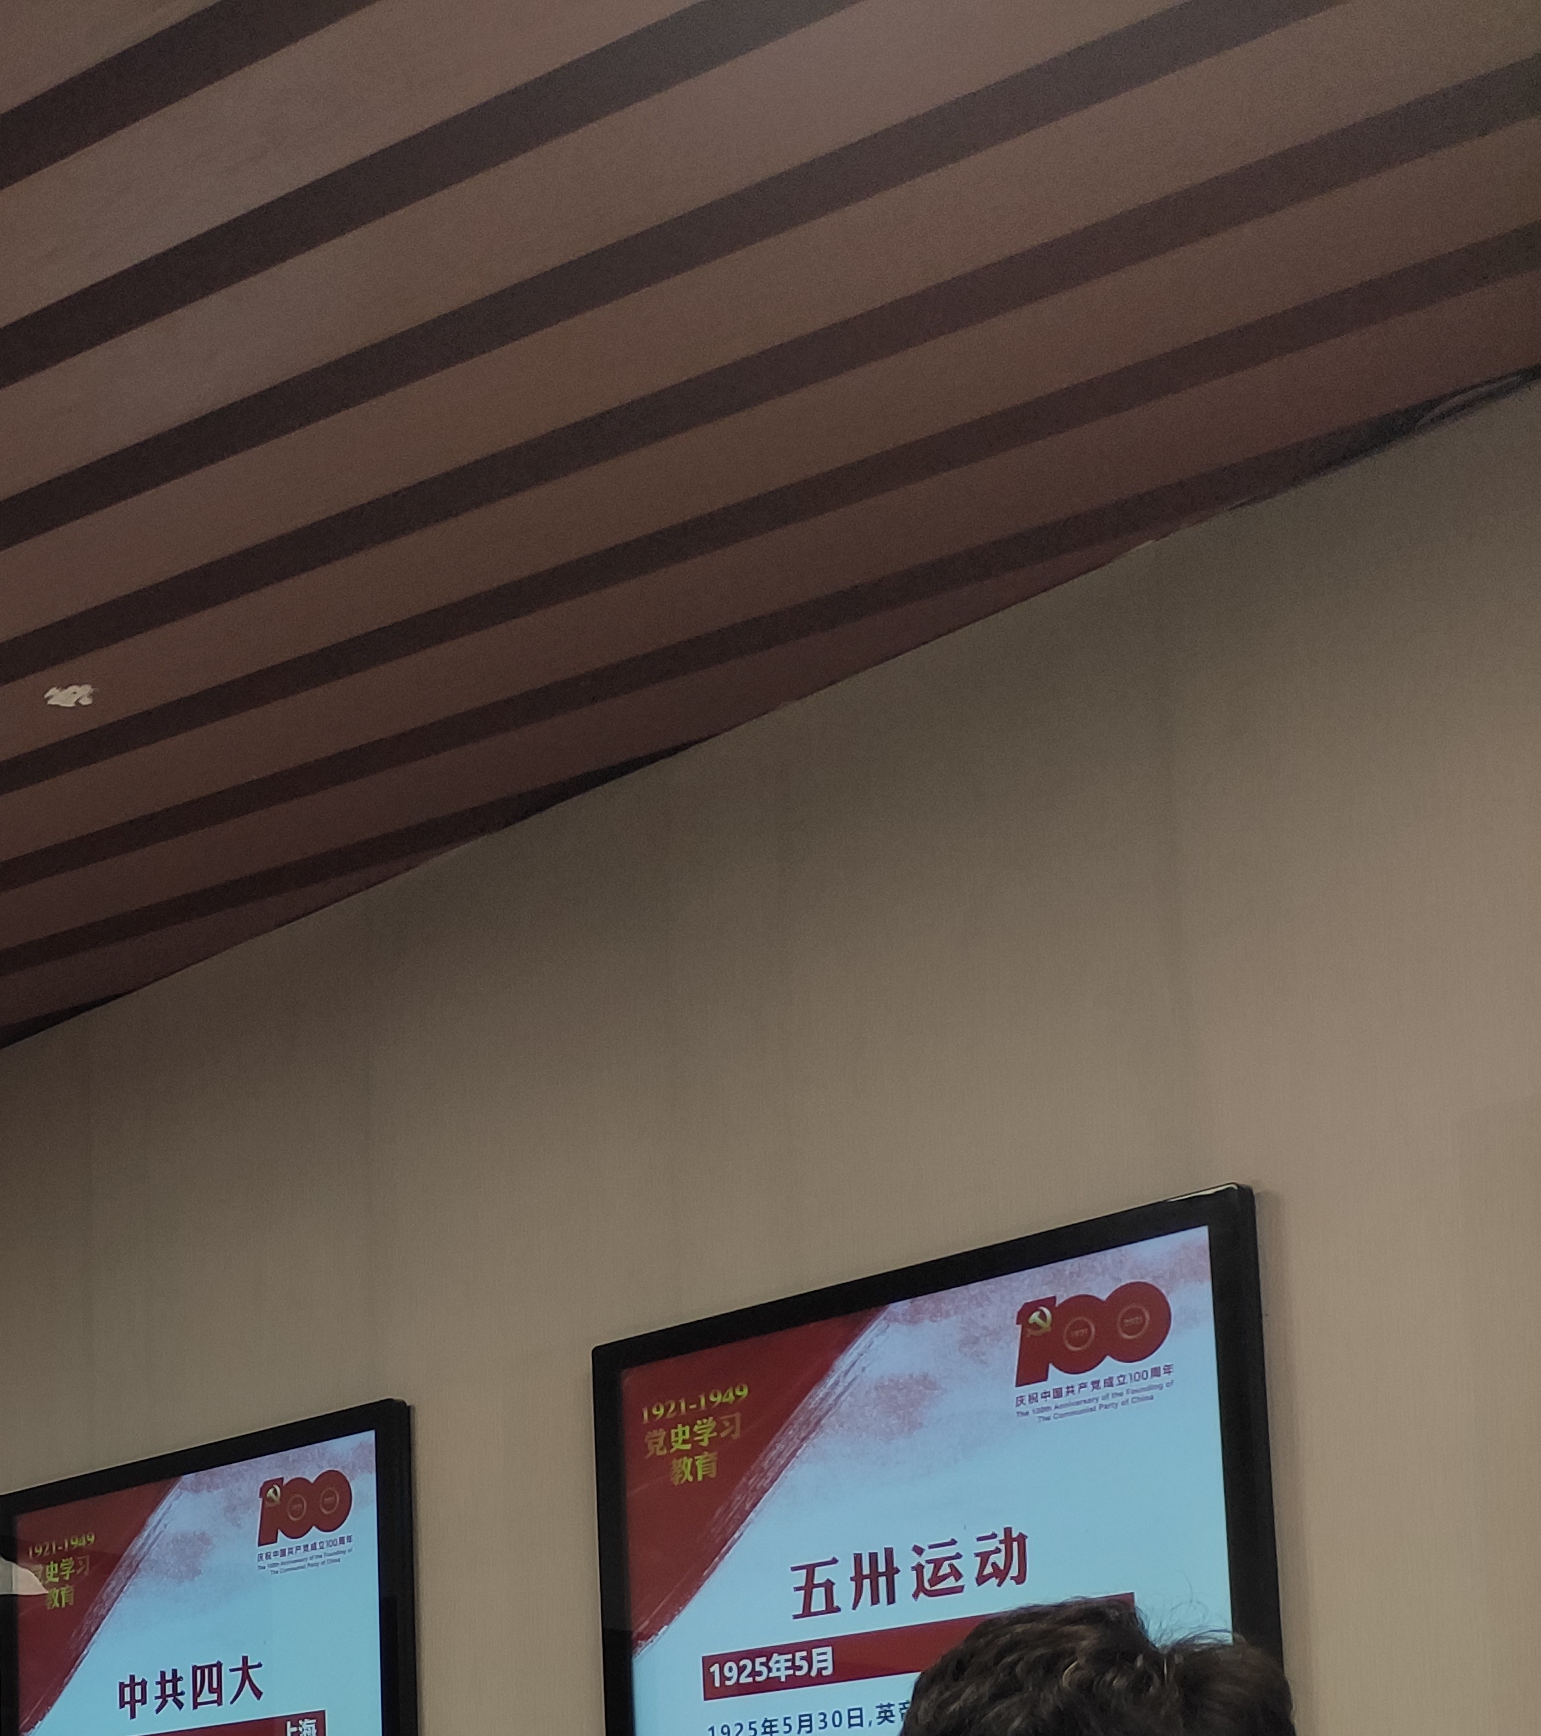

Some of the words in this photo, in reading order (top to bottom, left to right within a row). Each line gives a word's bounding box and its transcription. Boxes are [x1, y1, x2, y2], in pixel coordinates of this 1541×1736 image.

[1015, 1281, 1172, 1387] 100
[640, 1383, 749, 1425] 1921-1949
[1015, 1363, 1174, 1408] 庆祝中国共产党成立100周年
[643, 1413, 743, 1458] 党史学习
[670, 1451, 718, 1485] 教育
[258, 1470, 352, 1547] 100
[29, 1532, 95, 1559] 1921-1949
[789, 1525, 1030, 1620] 五卅运动
[46, 1584, 74, 1610] 教育
[118, 1655, 264, 1719] 中共四大
[708, 1645, 835, 1688] 1925年5月
